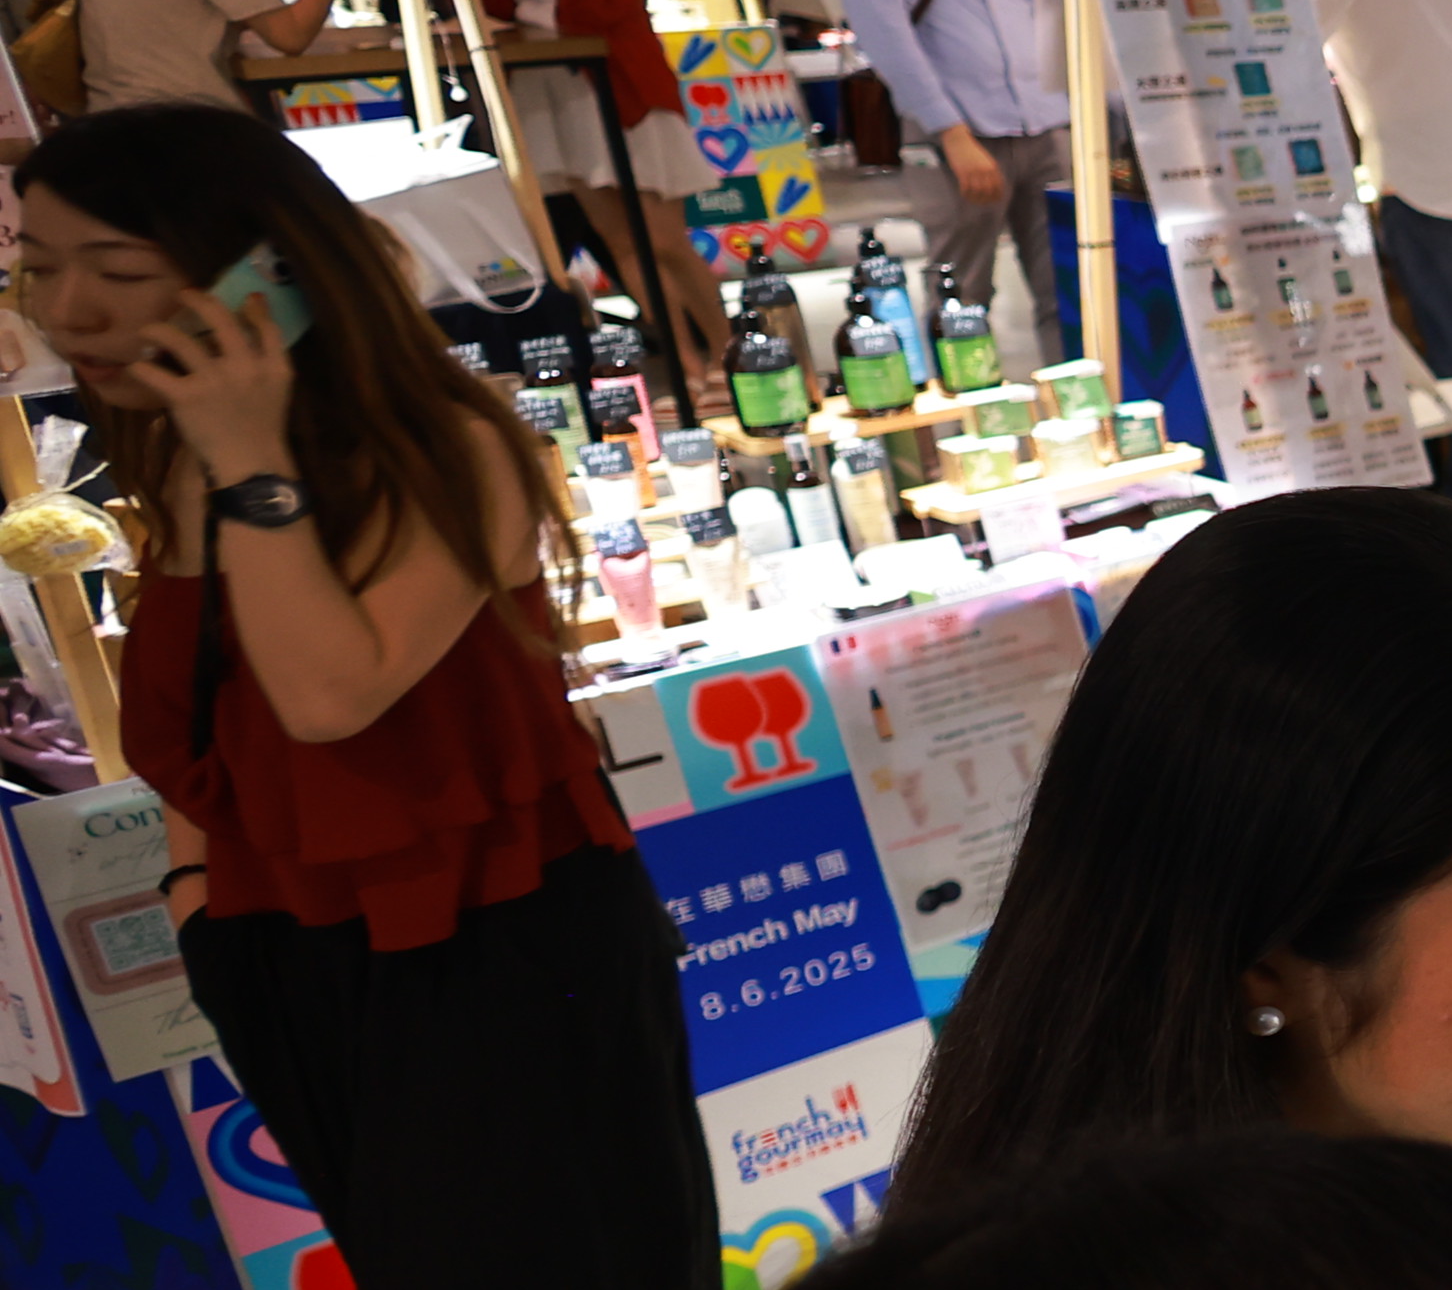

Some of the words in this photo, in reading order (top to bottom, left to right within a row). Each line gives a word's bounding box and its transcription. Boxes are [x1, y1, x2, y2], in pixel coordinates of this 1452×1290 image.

[677, 916, 789, 972] French
[794, 897, 860, 935] May
[700, 943, 876, 1020] 8.6.2025
